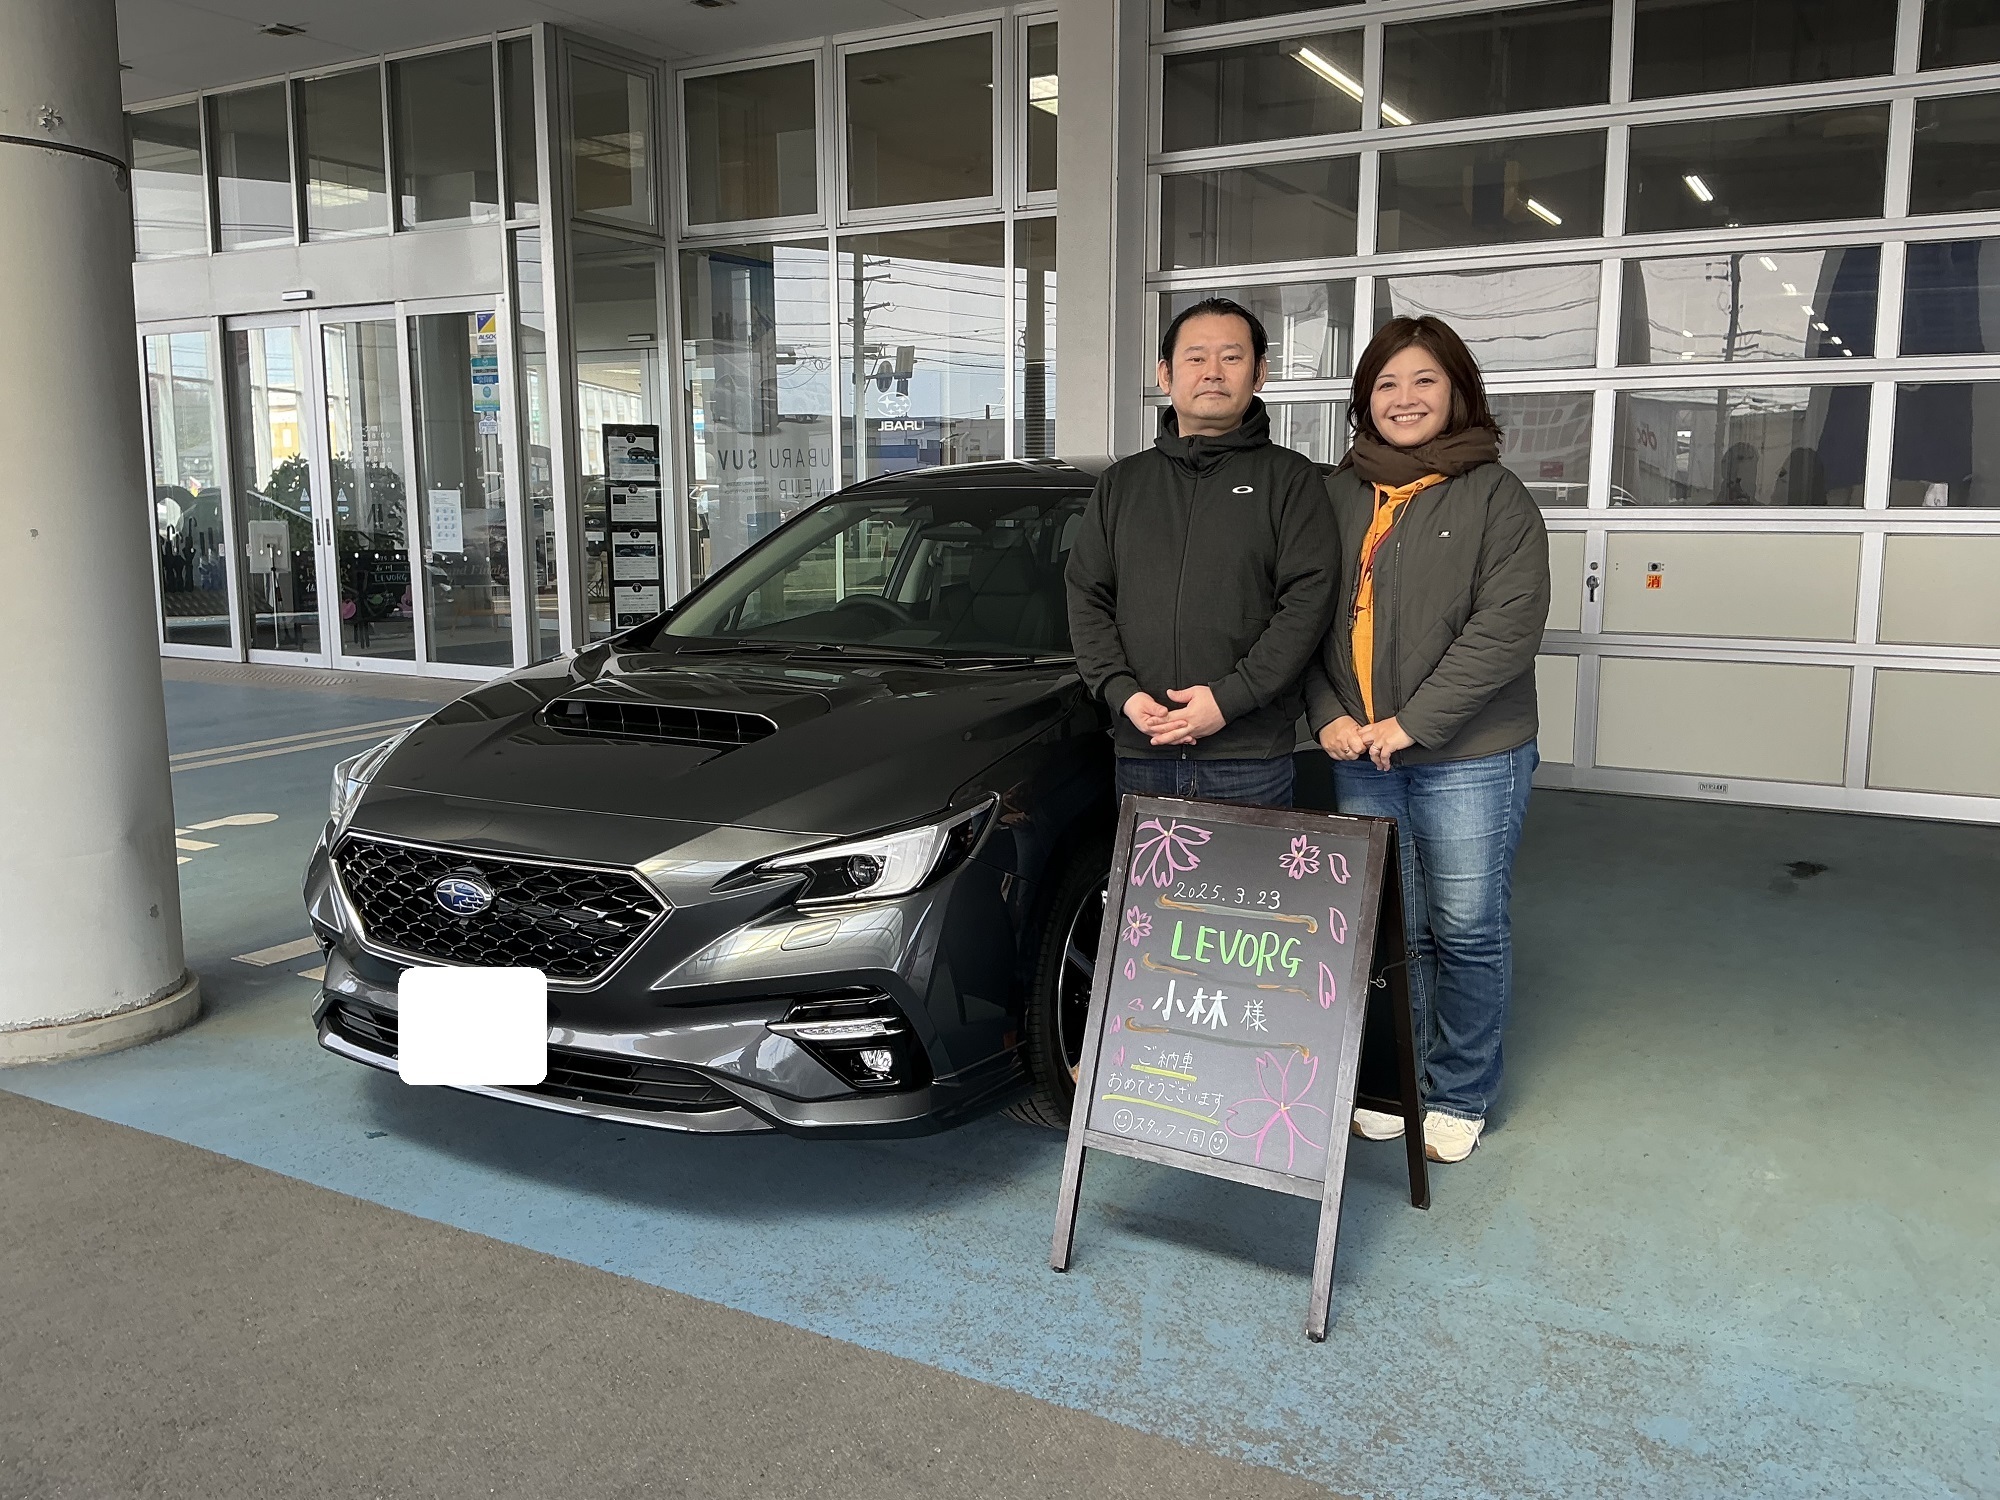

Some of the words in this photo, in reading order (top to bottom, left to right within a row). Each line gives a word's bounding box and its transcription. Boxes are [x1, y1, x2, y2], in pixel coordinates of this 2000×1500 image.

[877, 420, 925, 431] UBARU
[1647, 575, 1661, 588] 消
[1170, 920, 1304, 978] LEVORG
[1138, 1045, 1194, 1075] ご納車
[1107, 1072, 1225, 1118] おめでとうございます
